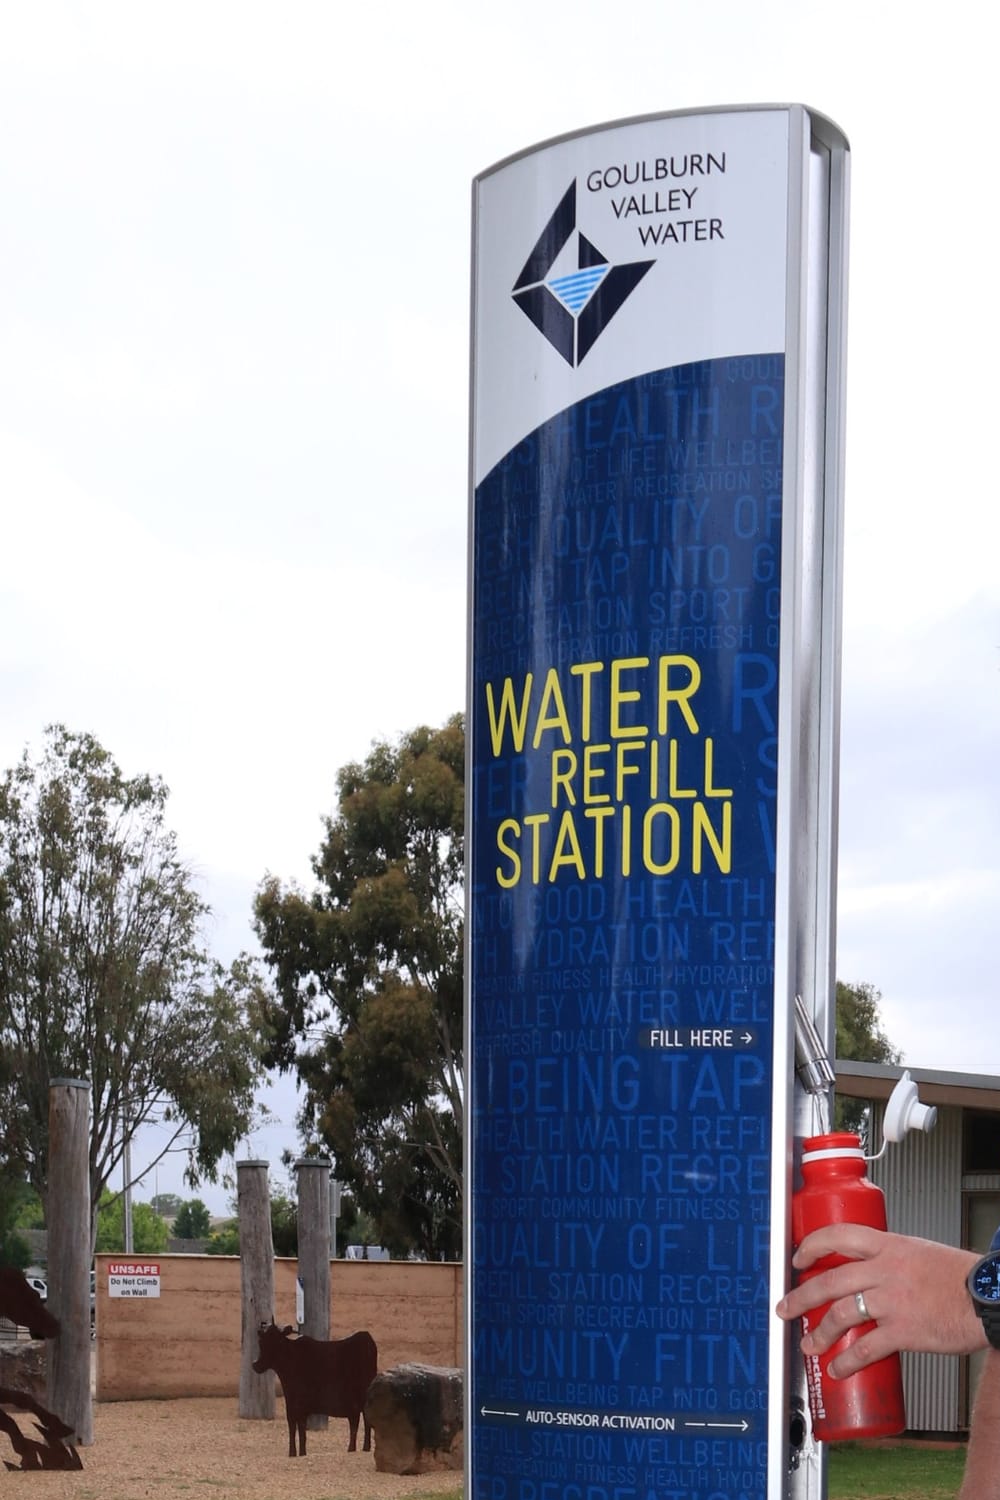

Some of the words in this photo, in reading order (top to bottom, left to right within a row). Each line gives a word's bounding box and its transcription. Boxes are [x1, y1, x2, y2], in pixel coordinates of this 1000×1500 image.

[586, 152, 726, 192] GOULBURN
[611, 187, 698, 219] VALLEY
[638, 218, 725, 246] WATER
[556, 386, 721, 455] HEALTH
[751, 384, 780, 435] R
[607, 444, 657, 477] LIFE
[634, 469, 751, 497] RECREATION
[551, 497, 711, 558] QUALITY
[570, 551, 630, 598] TAP
[648, 543, 731, 588] INTO
[752, 542, 776, 583] G
[648, 588, 749, 624] SPORT
[650, 624, 753, 652] REFRESH
[486, 654, 701, 757] WATER
[732, 652, 777, 736] R
[474, 756, 533, 818] ER
[552, 737, 733, 808] REFILL
[496, 801, 731, 888] STATION
[527, 883, 607, 928] GOOD
[624, 877, 766, 920] HEALTH
[512, 921, 690, 973] HYDRATION
[599, 964, 665, 988] HEALTH
[484, 992, 566, 1031] VALLEY
[577, 988, 679, 1026] WATER
[695, 988, 769, 1024] WEL
[551, 1028, 631, 1054] QUALITY
[650, 1030, 683, 1047] FILL
[690, 1030, 734, 1047] HERE
[660, 1053, 765, 1112] TAP
[480, 1116, 564, 1153] HEALTH
[576, 1115, 678, 1151] WATER
[502, 1152, 619, 1194] STATION
[493, 1196, 536, 1218] SPORT
[542, 1196, 646, 1220] COMMUNITY
[656, 1197, 740, 1220] FITNESS
[627, 1222, 687, 1270] OF
[110, 1265, 158, 1274] UNSAFE
[476, 1269, 538, 1300] REFILL
[548, 1271, 644, 1303] STATION
[517, 1302, 567, 1327] SPORT
[574, 1304, 694, 1329] RECREATION
[655, 1332, 756, 1384] FITN
[524, 1379, 619, 1406] WELLBEING
[627, 1384, 663, 1408] TAP
[811, 1354, 826, 1419] ockwell
[526, 1409, 600, 1427] AUTO-SENSOR
[602, 1413, 675, 1432] ACTIVATION
[530, 1430, 612, 1462] STATION
[575, 1463, 637, 1486] FITNESS
[645, 1467, 709, 1490] HEALTH
